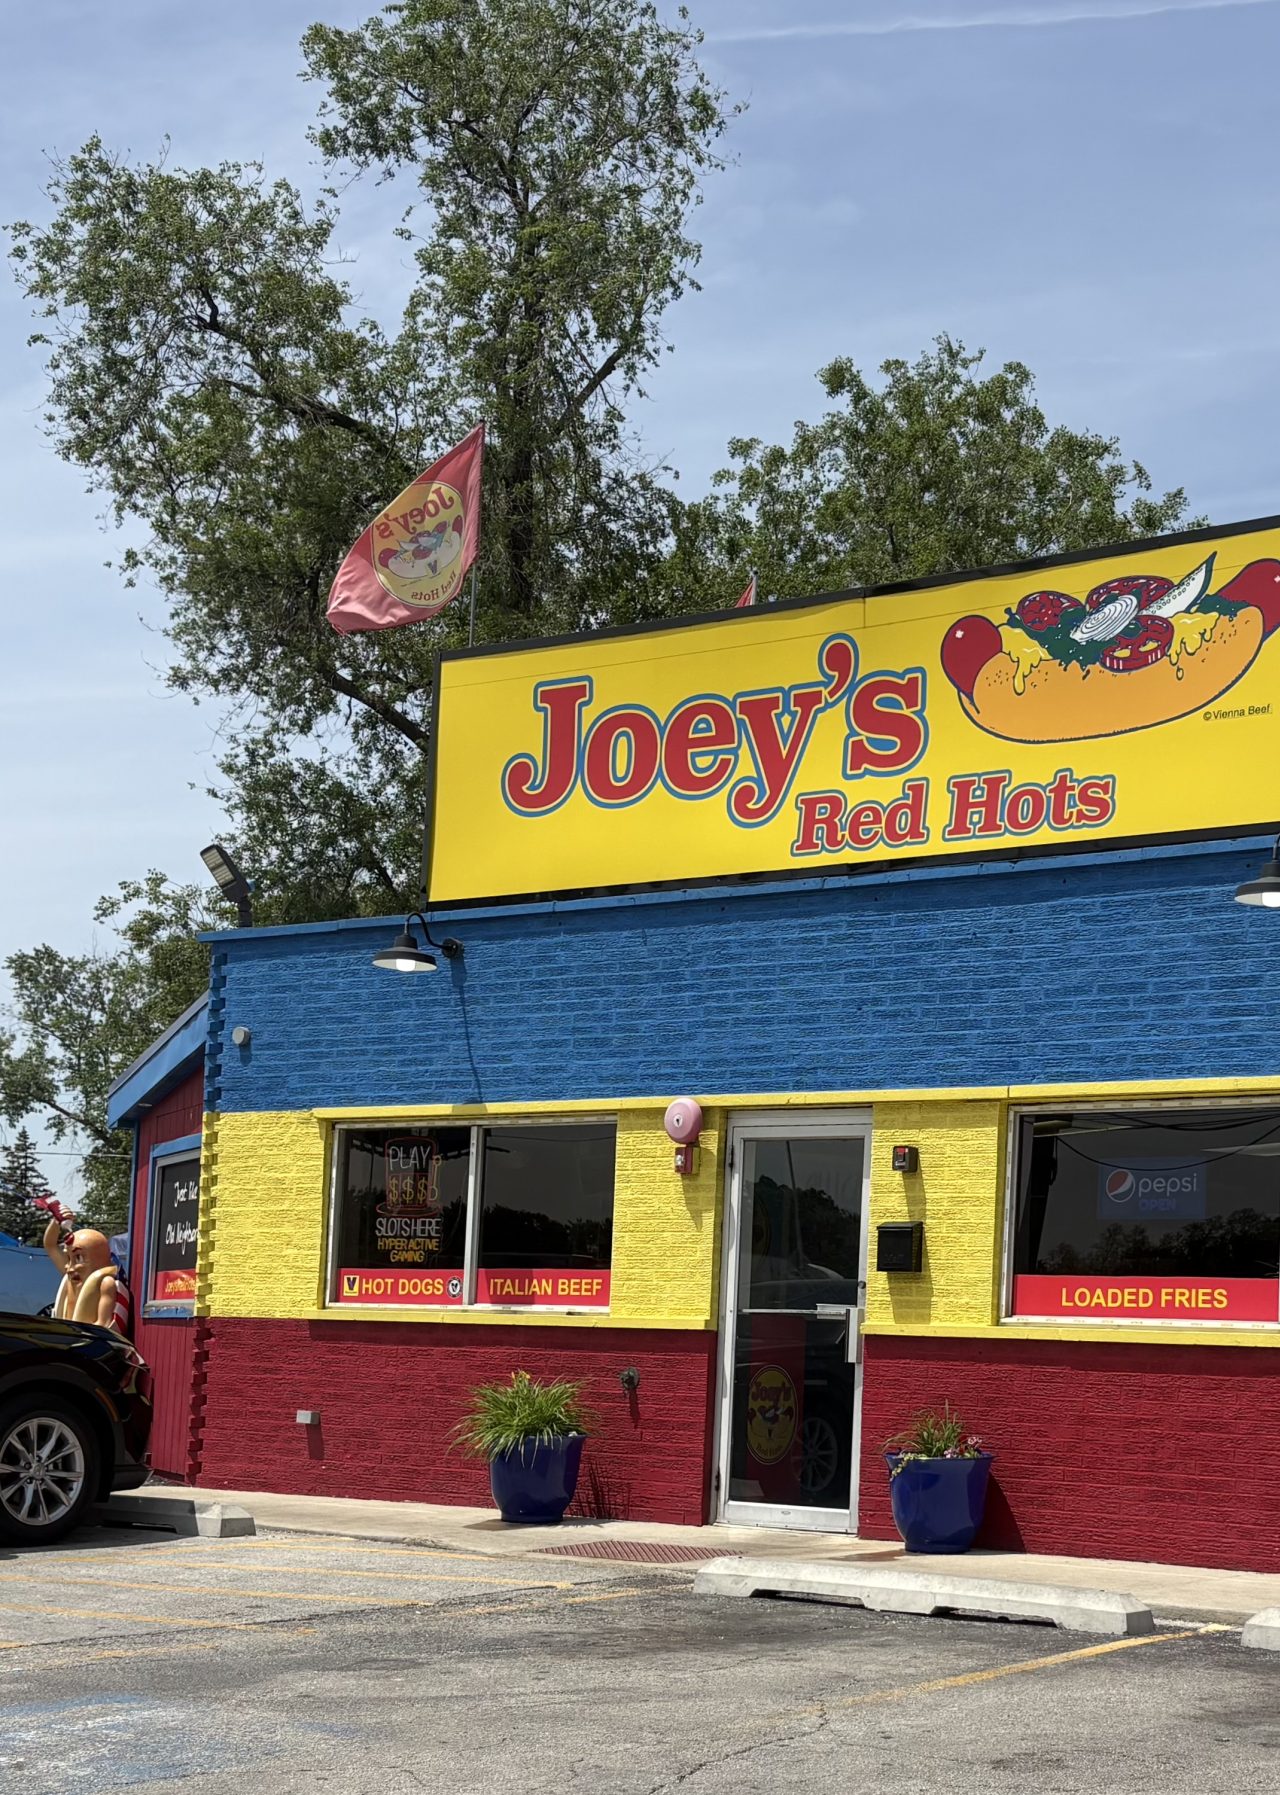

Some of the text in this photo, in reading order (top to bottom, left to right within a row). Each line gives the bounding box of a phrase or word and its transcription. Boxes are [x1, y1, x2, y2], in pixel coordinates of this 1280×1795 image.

[1248, 703, 1271, 715] Beef
[501, 633, 930, 829] Joey's
[790, 768, 1116, 857] Red Hots
[389, 1145, 431, 1171] PLAY
[1138, 1172, 1198, 1198] pepsi
[375, 1217, 441, 1237] SLOTS HERE
[390, 1250, 425, 1263] GAMING
[362, 1278, 395, 1295] HOT
[398, 1278, 444, 1296] DOGS
[489, 1278, 603, 1296] ITALIAN BEEF
[1061, 1287, 1228, 1309] LOADED FRIES
